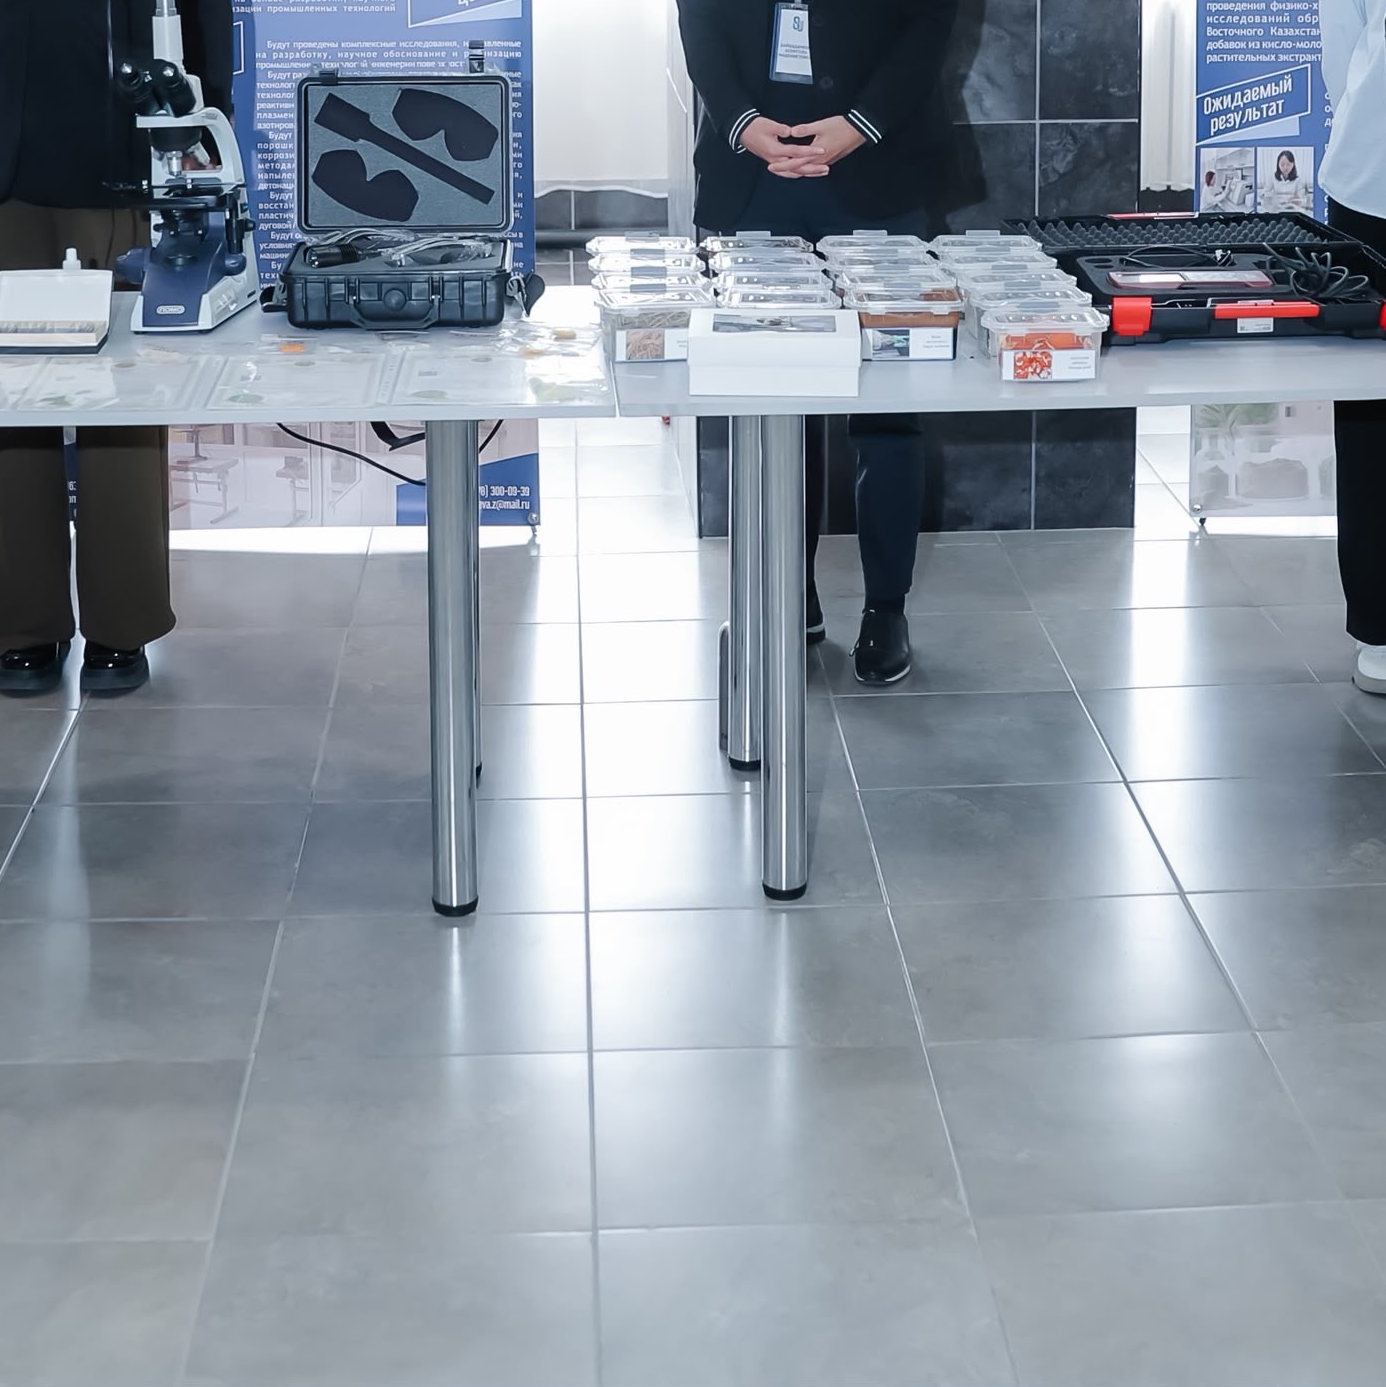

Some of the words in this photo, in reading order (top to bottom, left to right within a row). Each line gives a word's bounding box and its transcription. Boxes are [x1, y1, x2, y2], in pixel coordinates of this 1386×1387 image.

[1270, 26, 1321, 35] Казахстан
[1285, 53, 1322, 63] экстракт
[1203, 75, 1292, 114] Ожидаемый
[1210, 99, 1284, 135] результат
